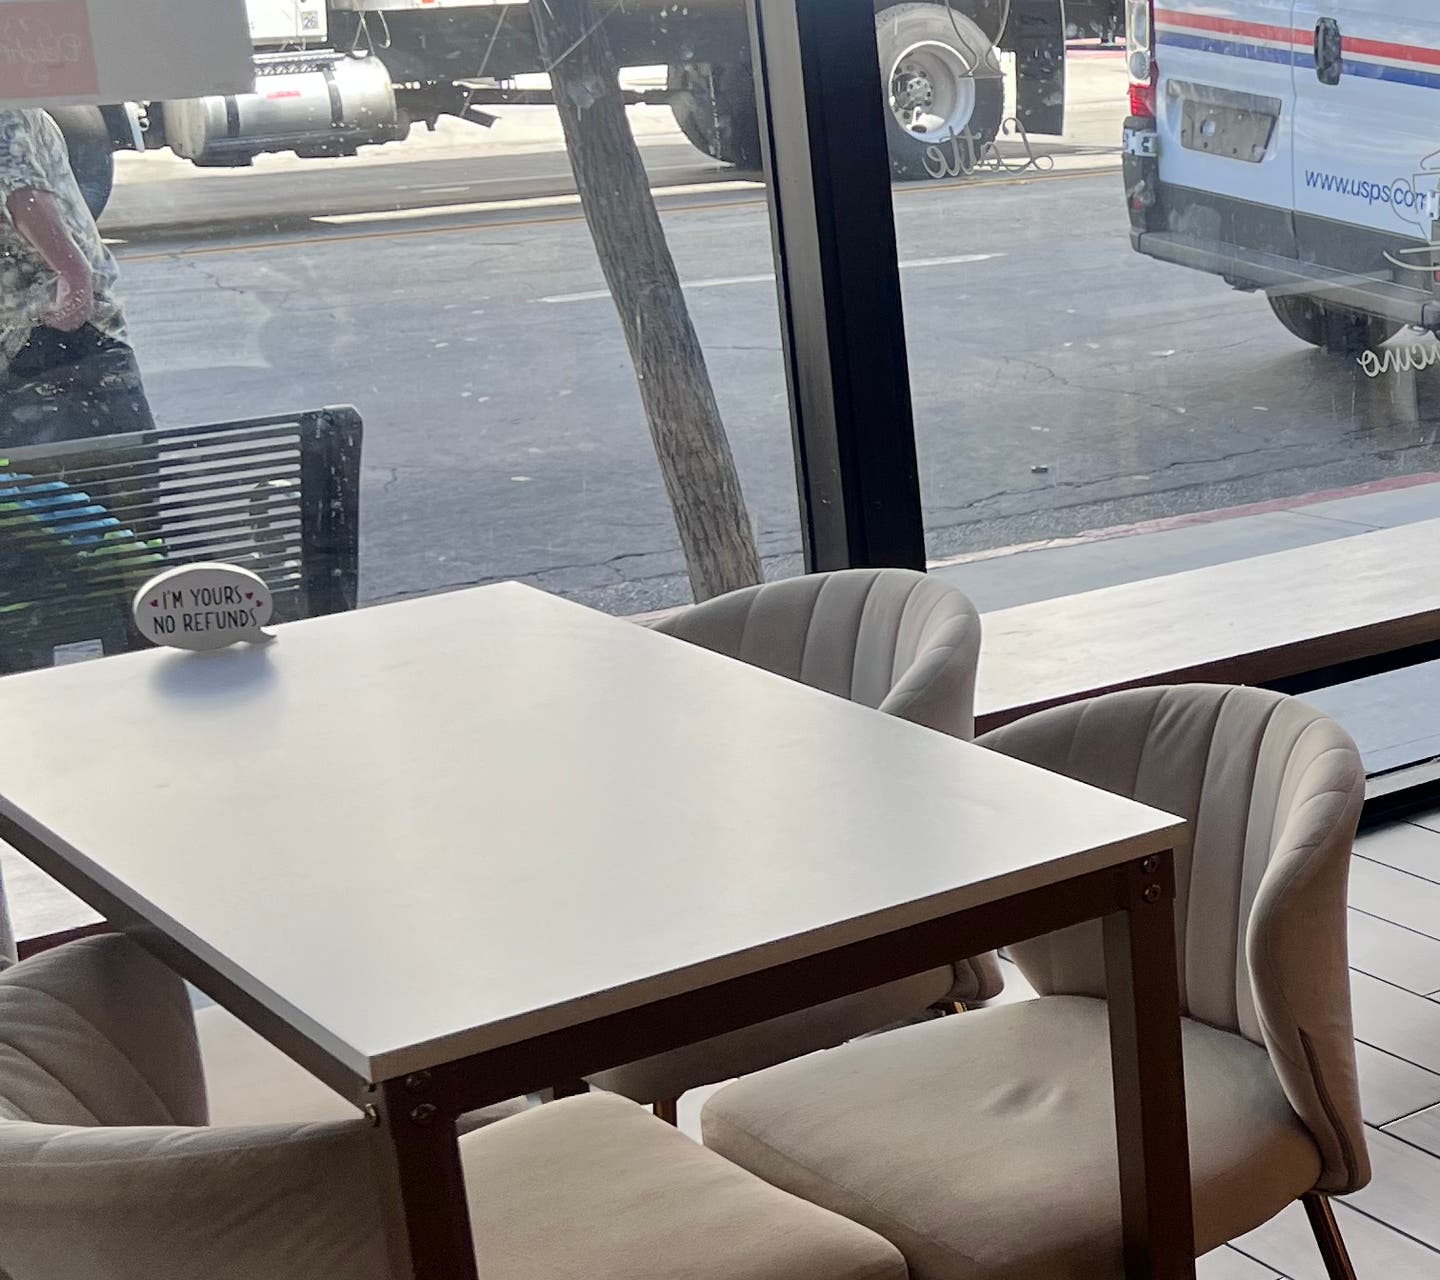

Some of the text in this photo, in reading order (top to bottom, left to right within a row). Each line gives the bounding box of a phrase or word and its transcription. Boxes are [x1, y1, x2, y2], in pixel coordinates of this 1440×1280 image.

[162, 585, 243, 610] I'M YOURS
[153, 607, 258, 634] NO REFUNDS
